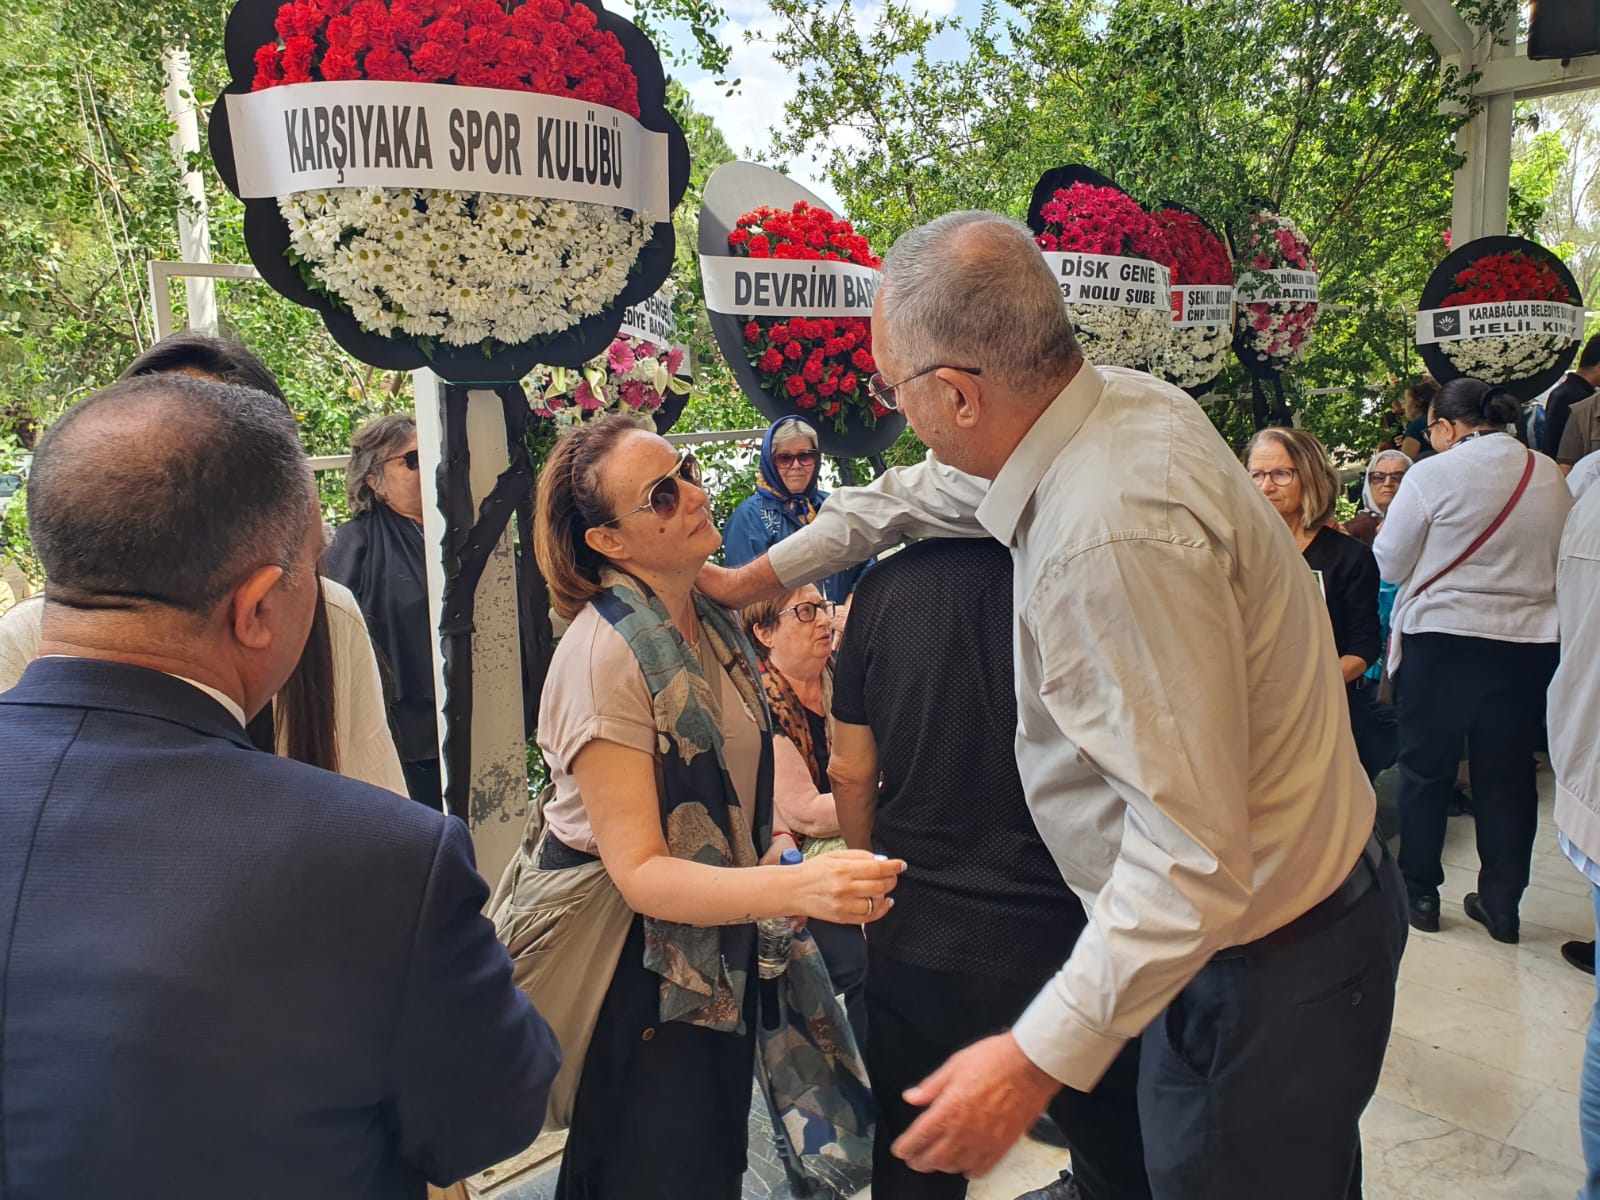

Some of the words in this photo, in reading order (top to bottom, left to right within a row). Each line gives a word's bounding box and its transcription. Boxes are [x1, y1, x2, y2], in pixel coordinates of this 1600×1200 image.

[284, 104, 433, 184] KARŞIYAKA
[449, 108, 522, 176] SPOR
[537, 110, 623, 189] KULÜBÜ
[1061, 256, 1110, 279] DİSK
[735, 265, 836, 308] DEVRİM
[843, 274, 880, 308] BAR
[1060, 283, 1071, 297] 3
[1080, 284, 1120, 301] NOLU
[1125, 288, 1156, 305] ŞUBE
[1187, 309, 1205, 322] CHP
[1469, 302, 1529, 321] KARABAĞLAR
[1469, 319, 1537, 336] HELİL
